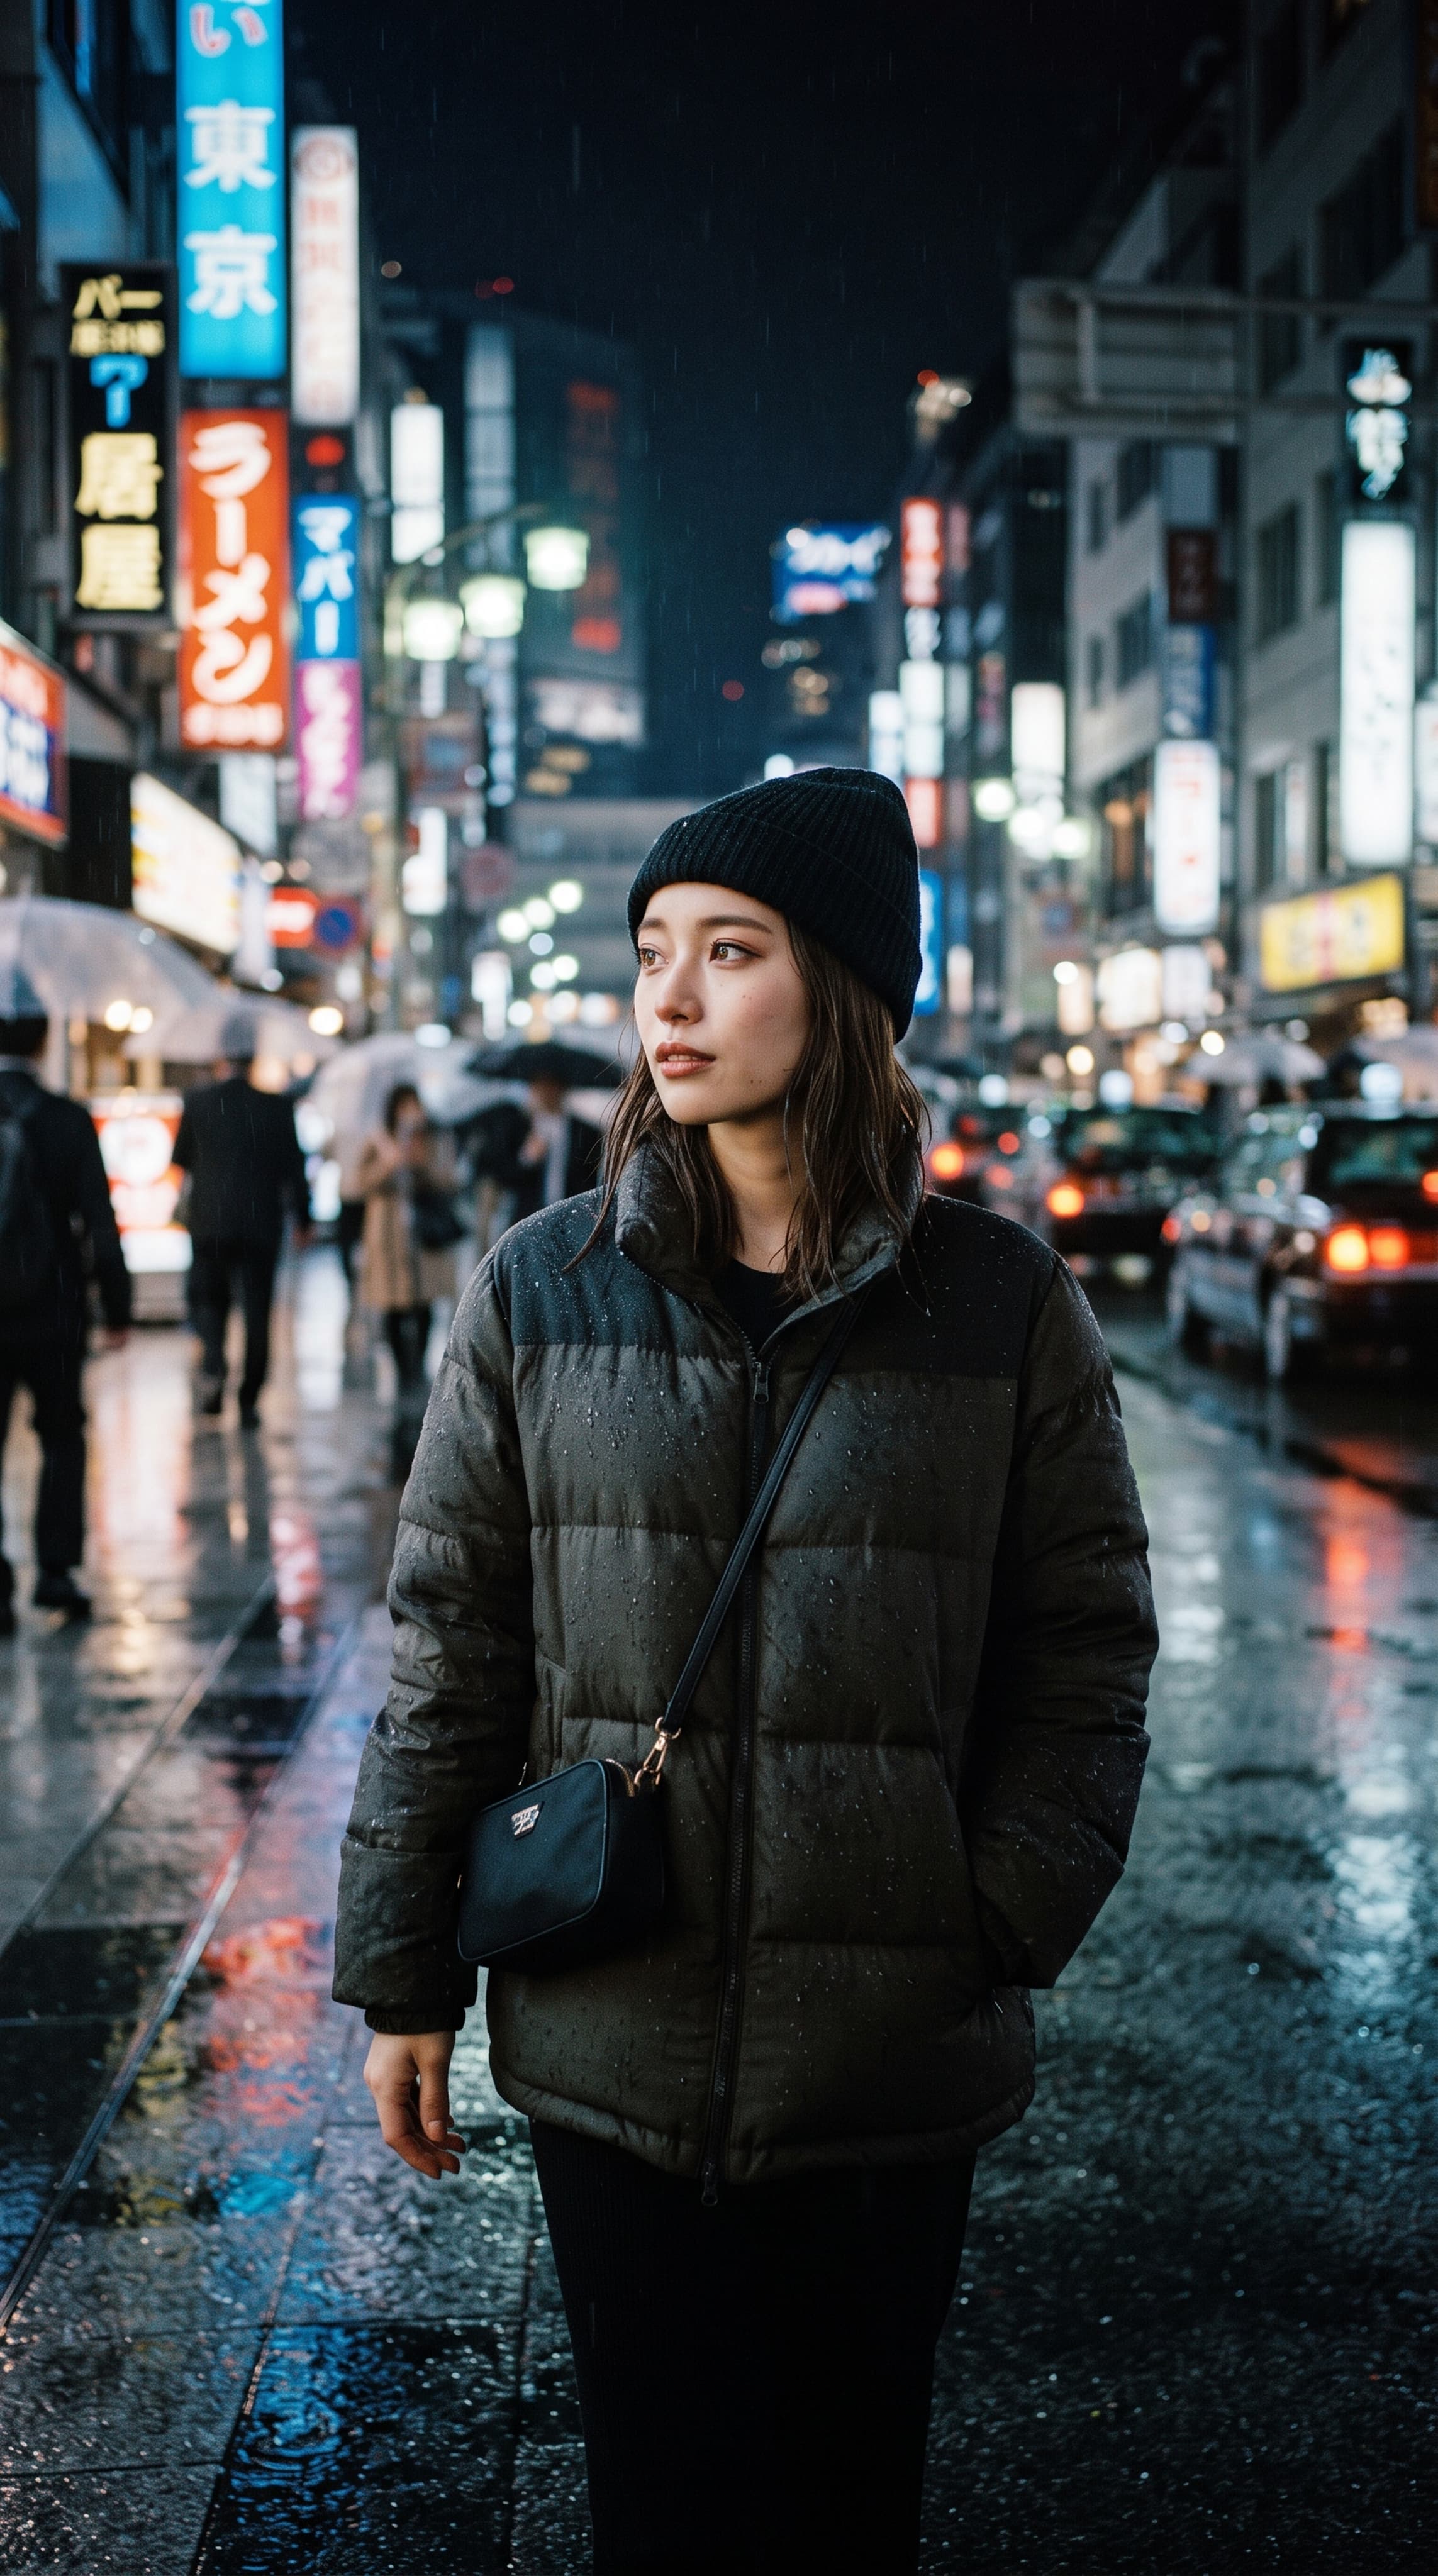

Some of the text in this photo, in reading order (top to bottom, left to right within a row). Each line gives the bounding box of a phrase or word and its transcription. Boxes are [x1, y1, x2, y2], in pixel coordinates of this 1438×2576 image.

[184, 0, 277, 319] い東京
[189, 421, 272, 704] ラーメン
